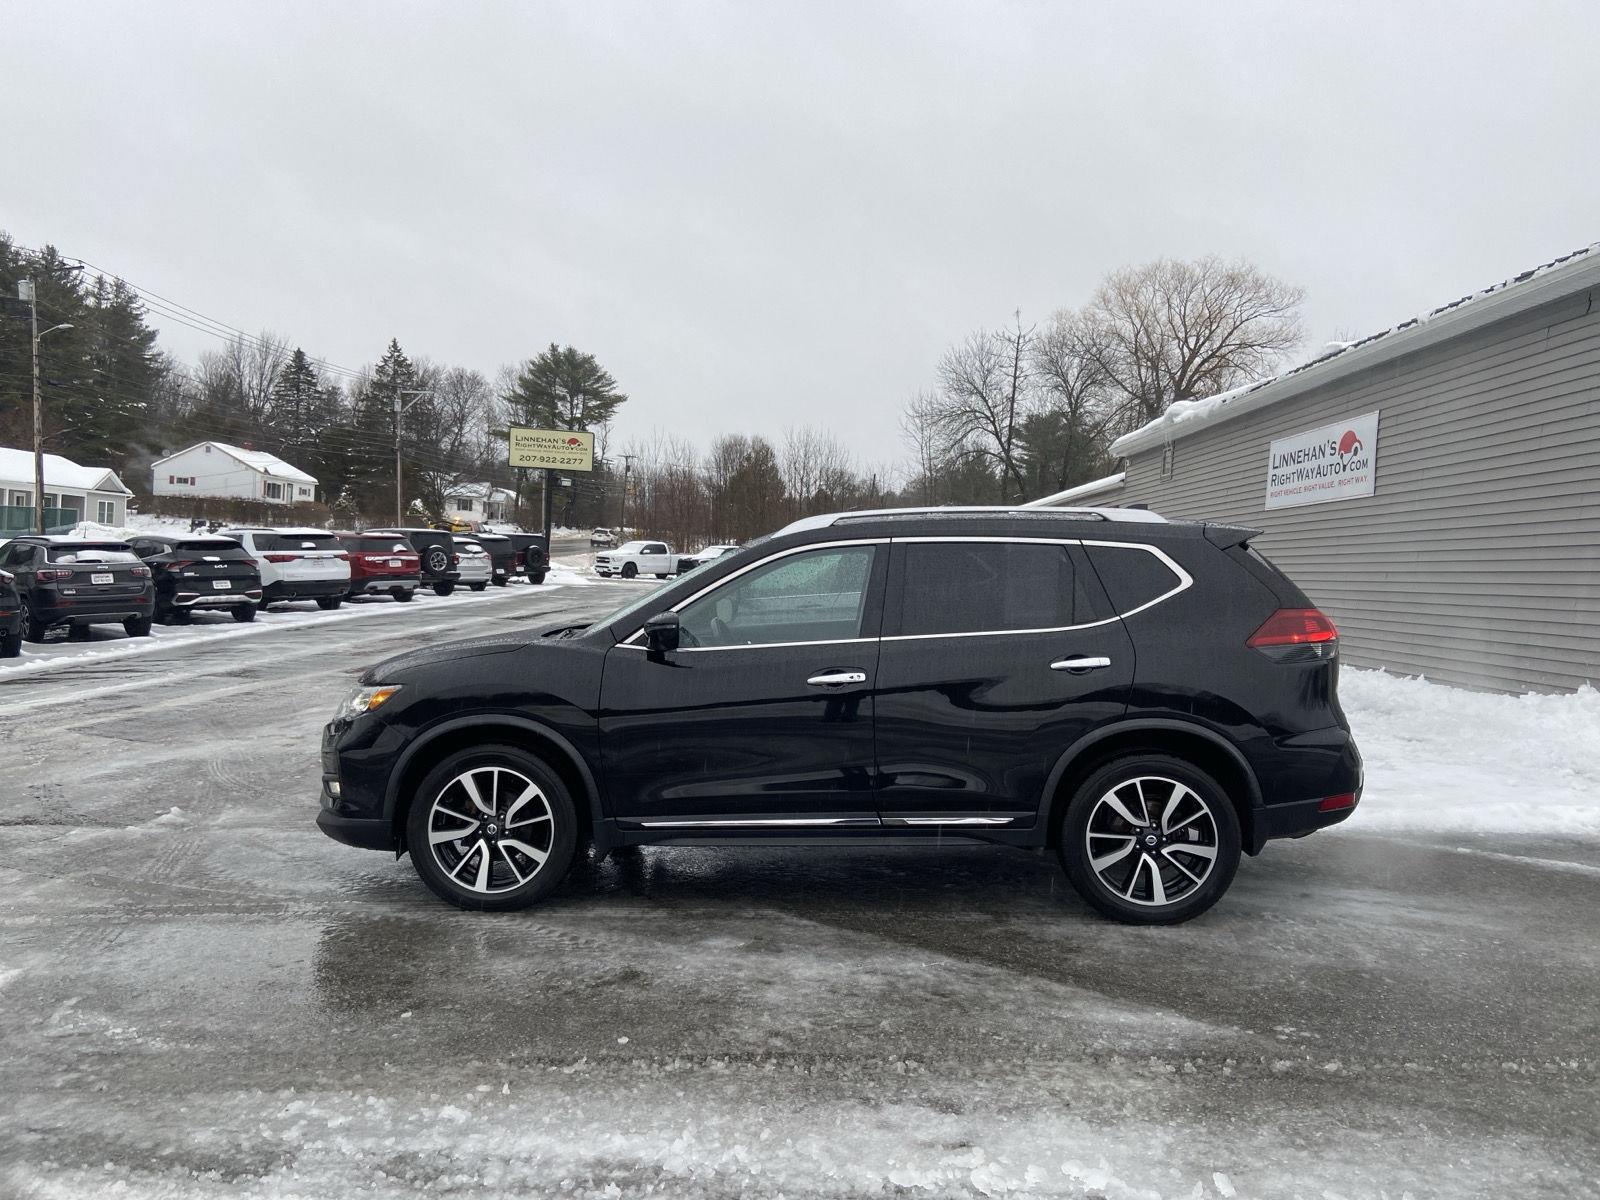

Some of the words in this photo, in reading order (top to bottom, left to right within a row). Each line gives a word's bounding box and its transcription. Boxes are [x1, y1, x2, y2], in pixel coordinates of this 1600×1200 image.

[515, 435, 567, 445] LINNEHAN'S
[519, 454, 584, 465] 207-922-2277
[1272, 439, 1337, 470] LINNEHAN'S
